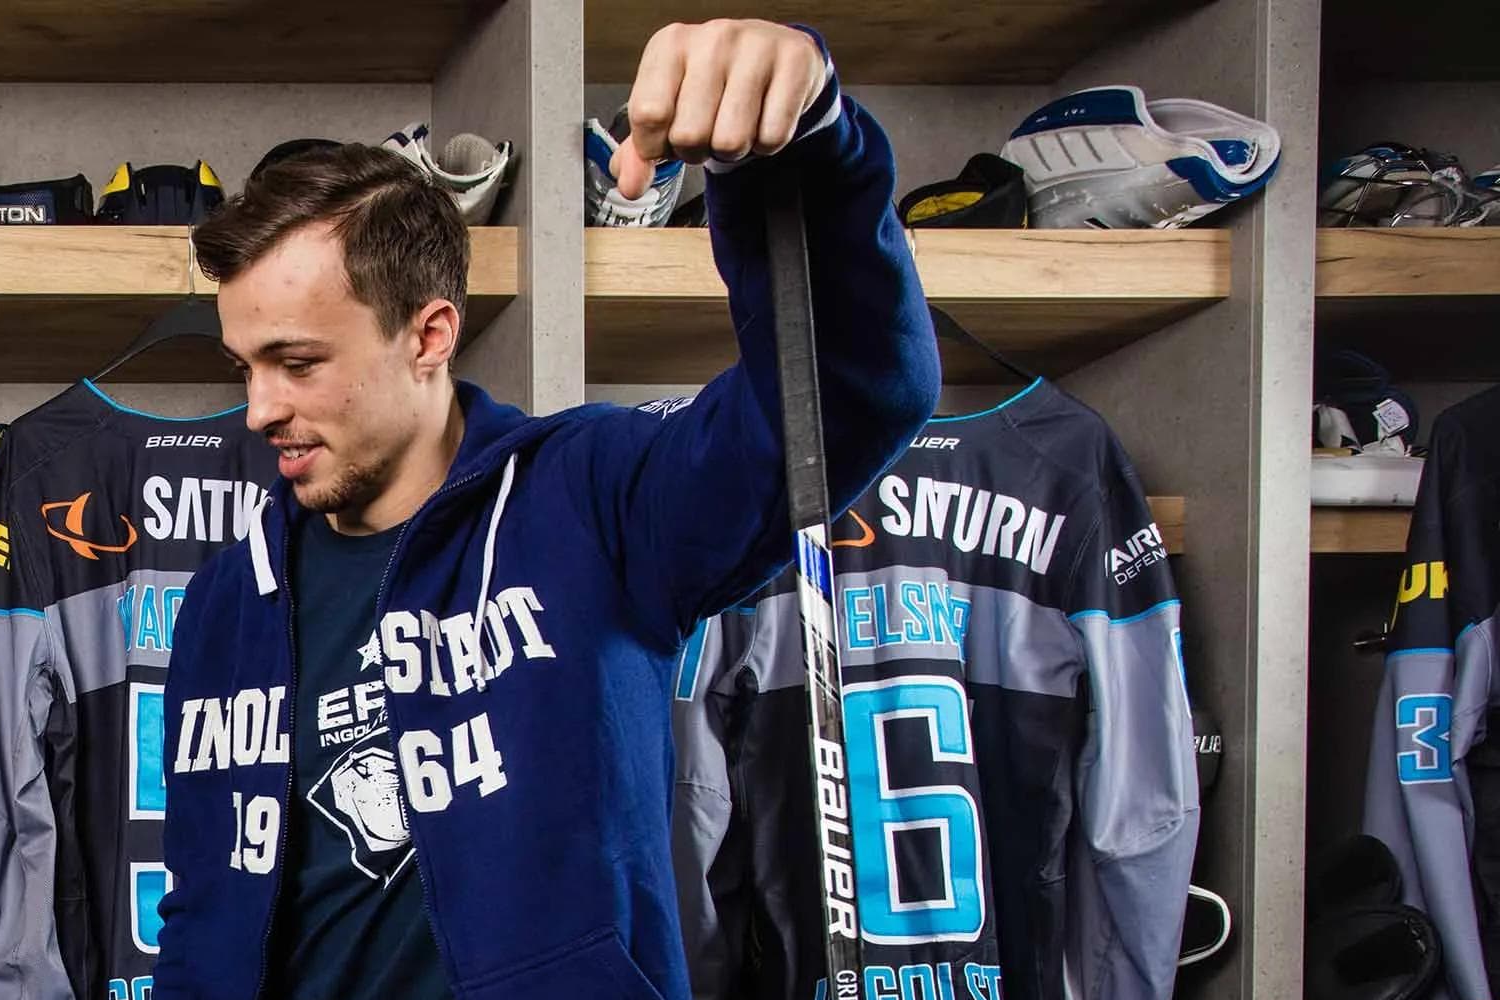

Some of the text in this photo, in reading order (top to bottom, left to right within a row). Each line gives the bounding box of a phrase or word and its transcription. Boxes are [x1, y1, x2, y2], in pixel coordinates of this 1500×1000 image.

[878, 475, 1067, 576] SATURN
[398, 711, 509, 814] 64
[1396, 693, 1453, 785] 3
[229, 791, 282, 875] 19
[838, 674, 988, 946] 6
